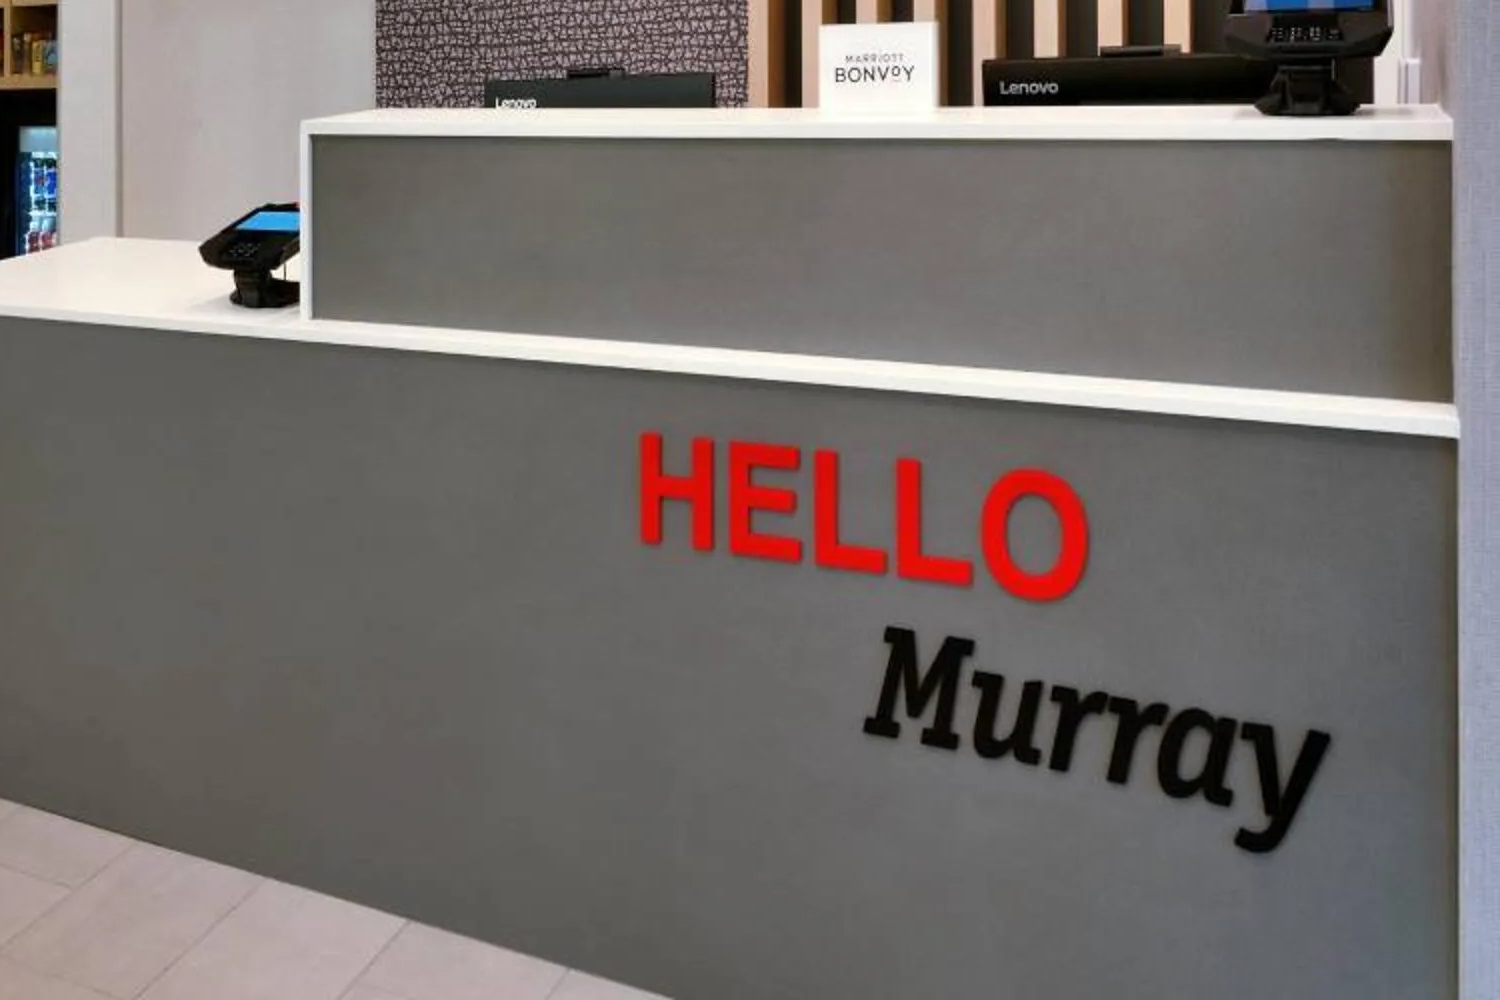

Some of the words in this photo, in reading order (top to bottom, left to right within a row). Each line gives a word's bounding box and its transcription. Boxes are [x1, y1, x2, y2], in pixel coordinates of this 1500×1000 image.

[845, 53, 904, 64] MARRIOTT
[834, 65, 915, 83] BONVOY
[1000, 81, 1059, 95] Lenovo
[495, 97, 537, 108] Lenovo
[639, 432, 1088, 602] HELLO
[862, 626, 1332, 854] Murray
